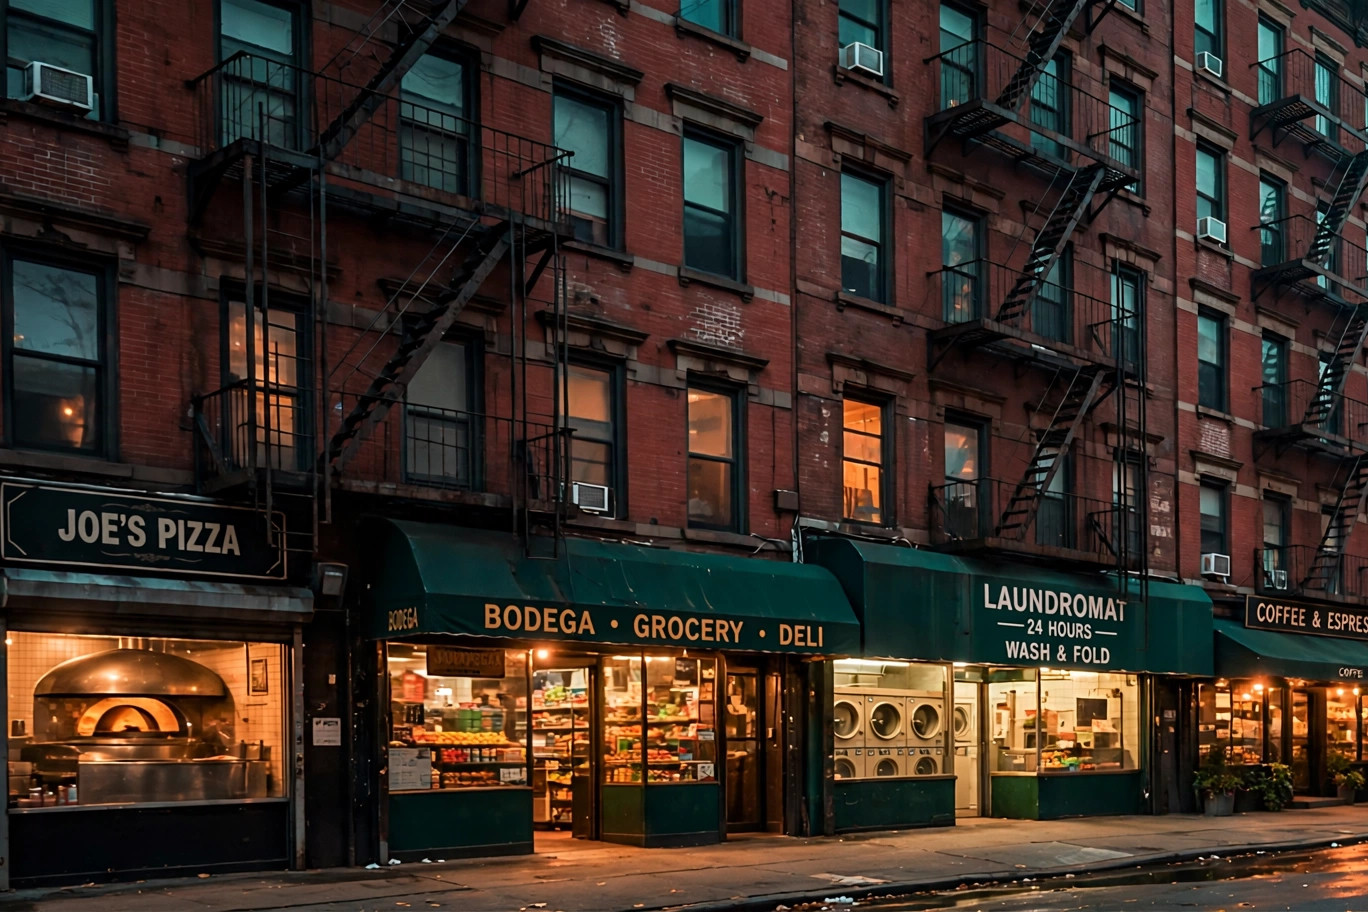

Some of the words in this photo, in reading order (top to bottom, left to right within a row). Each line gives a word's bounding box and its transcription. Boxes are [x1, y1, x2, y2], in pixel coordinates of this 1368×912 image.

[58, 509, 147, 548] JOE'S
[158, 517, 241, 556] PIZZA
[984, 583, 1128, 622] LAUNDROMAT
[1256, 602, 1306, 627] COFFEE
[1312, 610, 1321, 628] &
[388, 606, 418, 632] BODEGA
[484, 603, 596, 635] BODEGA
[633, 613, 744, 643] GROCERY
[779, 623, 823, 648] DELI
[1027, 618, 1043, 635] 24
[1048, 621, 1092, 640] HOURS
[1005, 640, 1050, 662] WASH
[1057, 644, 1067, 662] &
[1073, 645, 1110, 664] FOLD
